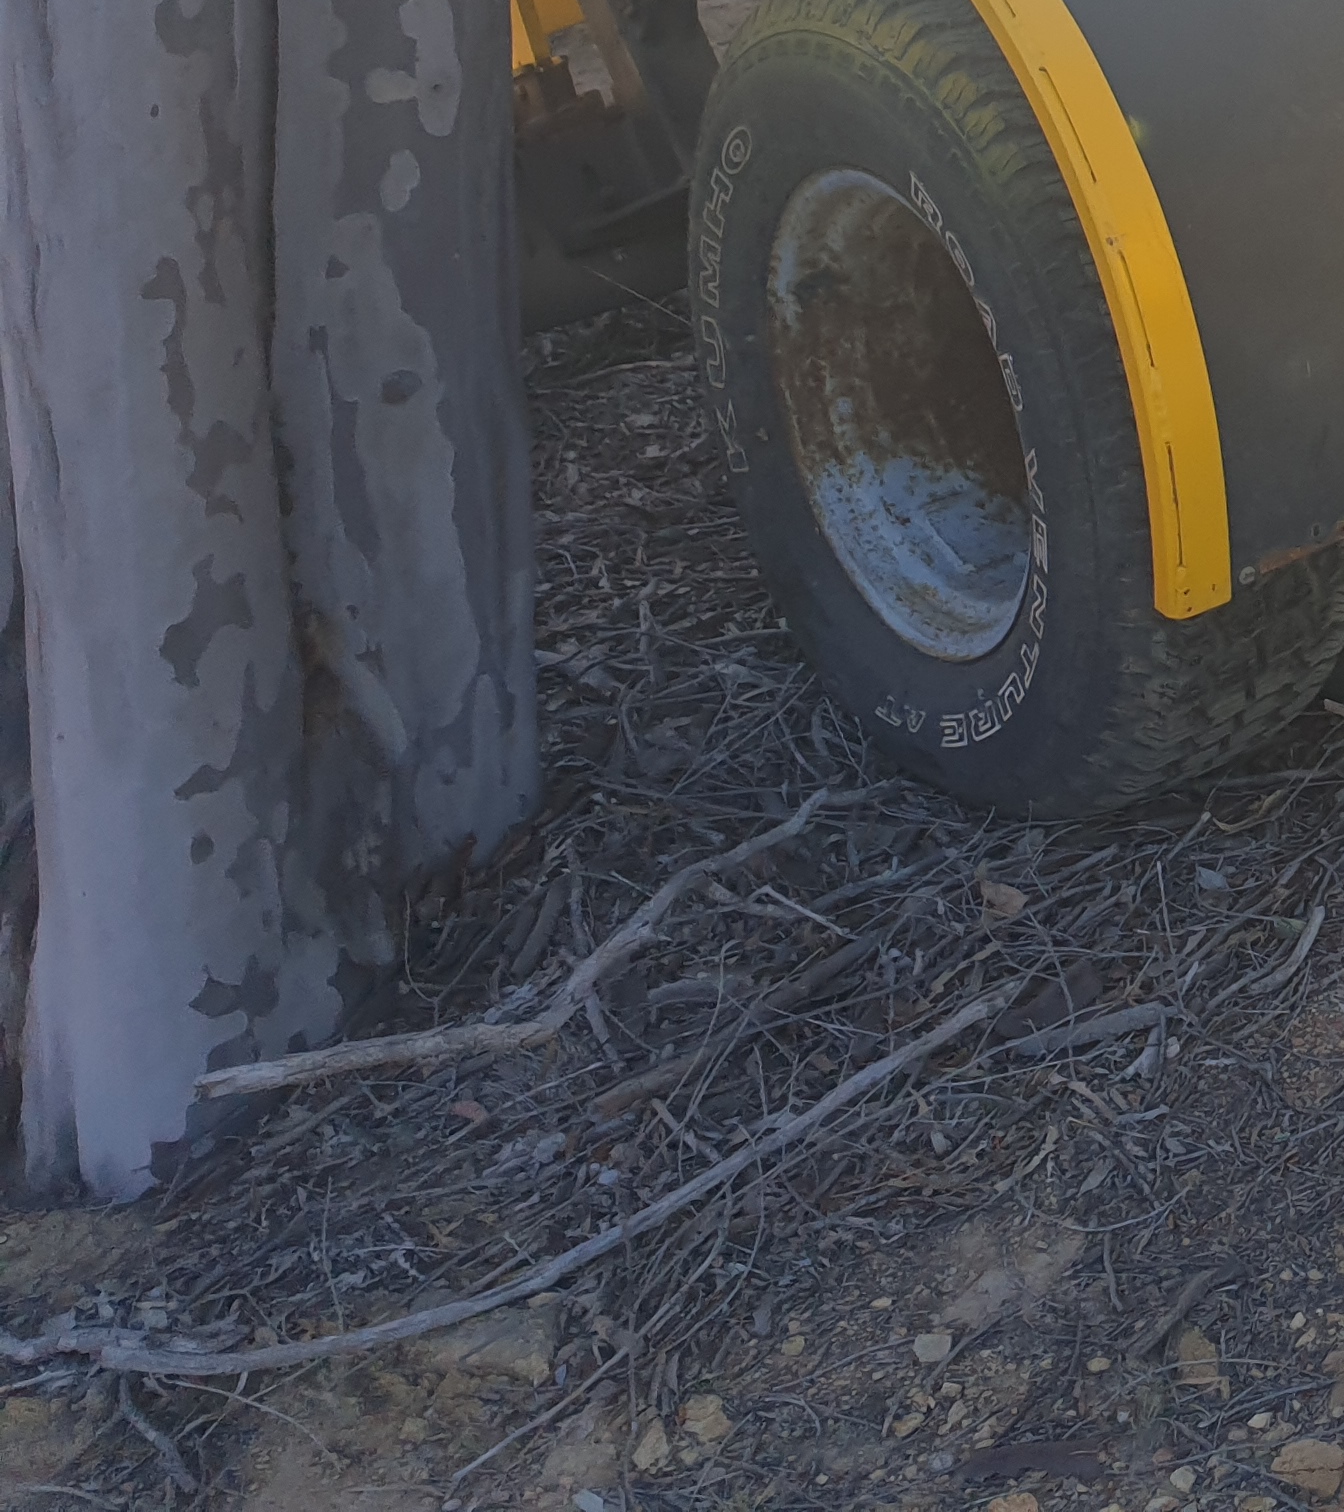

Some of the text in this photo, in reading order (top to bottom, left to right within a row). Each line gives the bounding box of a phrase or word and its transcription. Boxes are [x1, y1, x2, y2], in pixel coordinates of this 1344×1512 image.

[699, 125, 753, 473] KUMHO
[908, 170, 1024, 412] ROAD
[939, 447, 1049, 748] VENTURE
